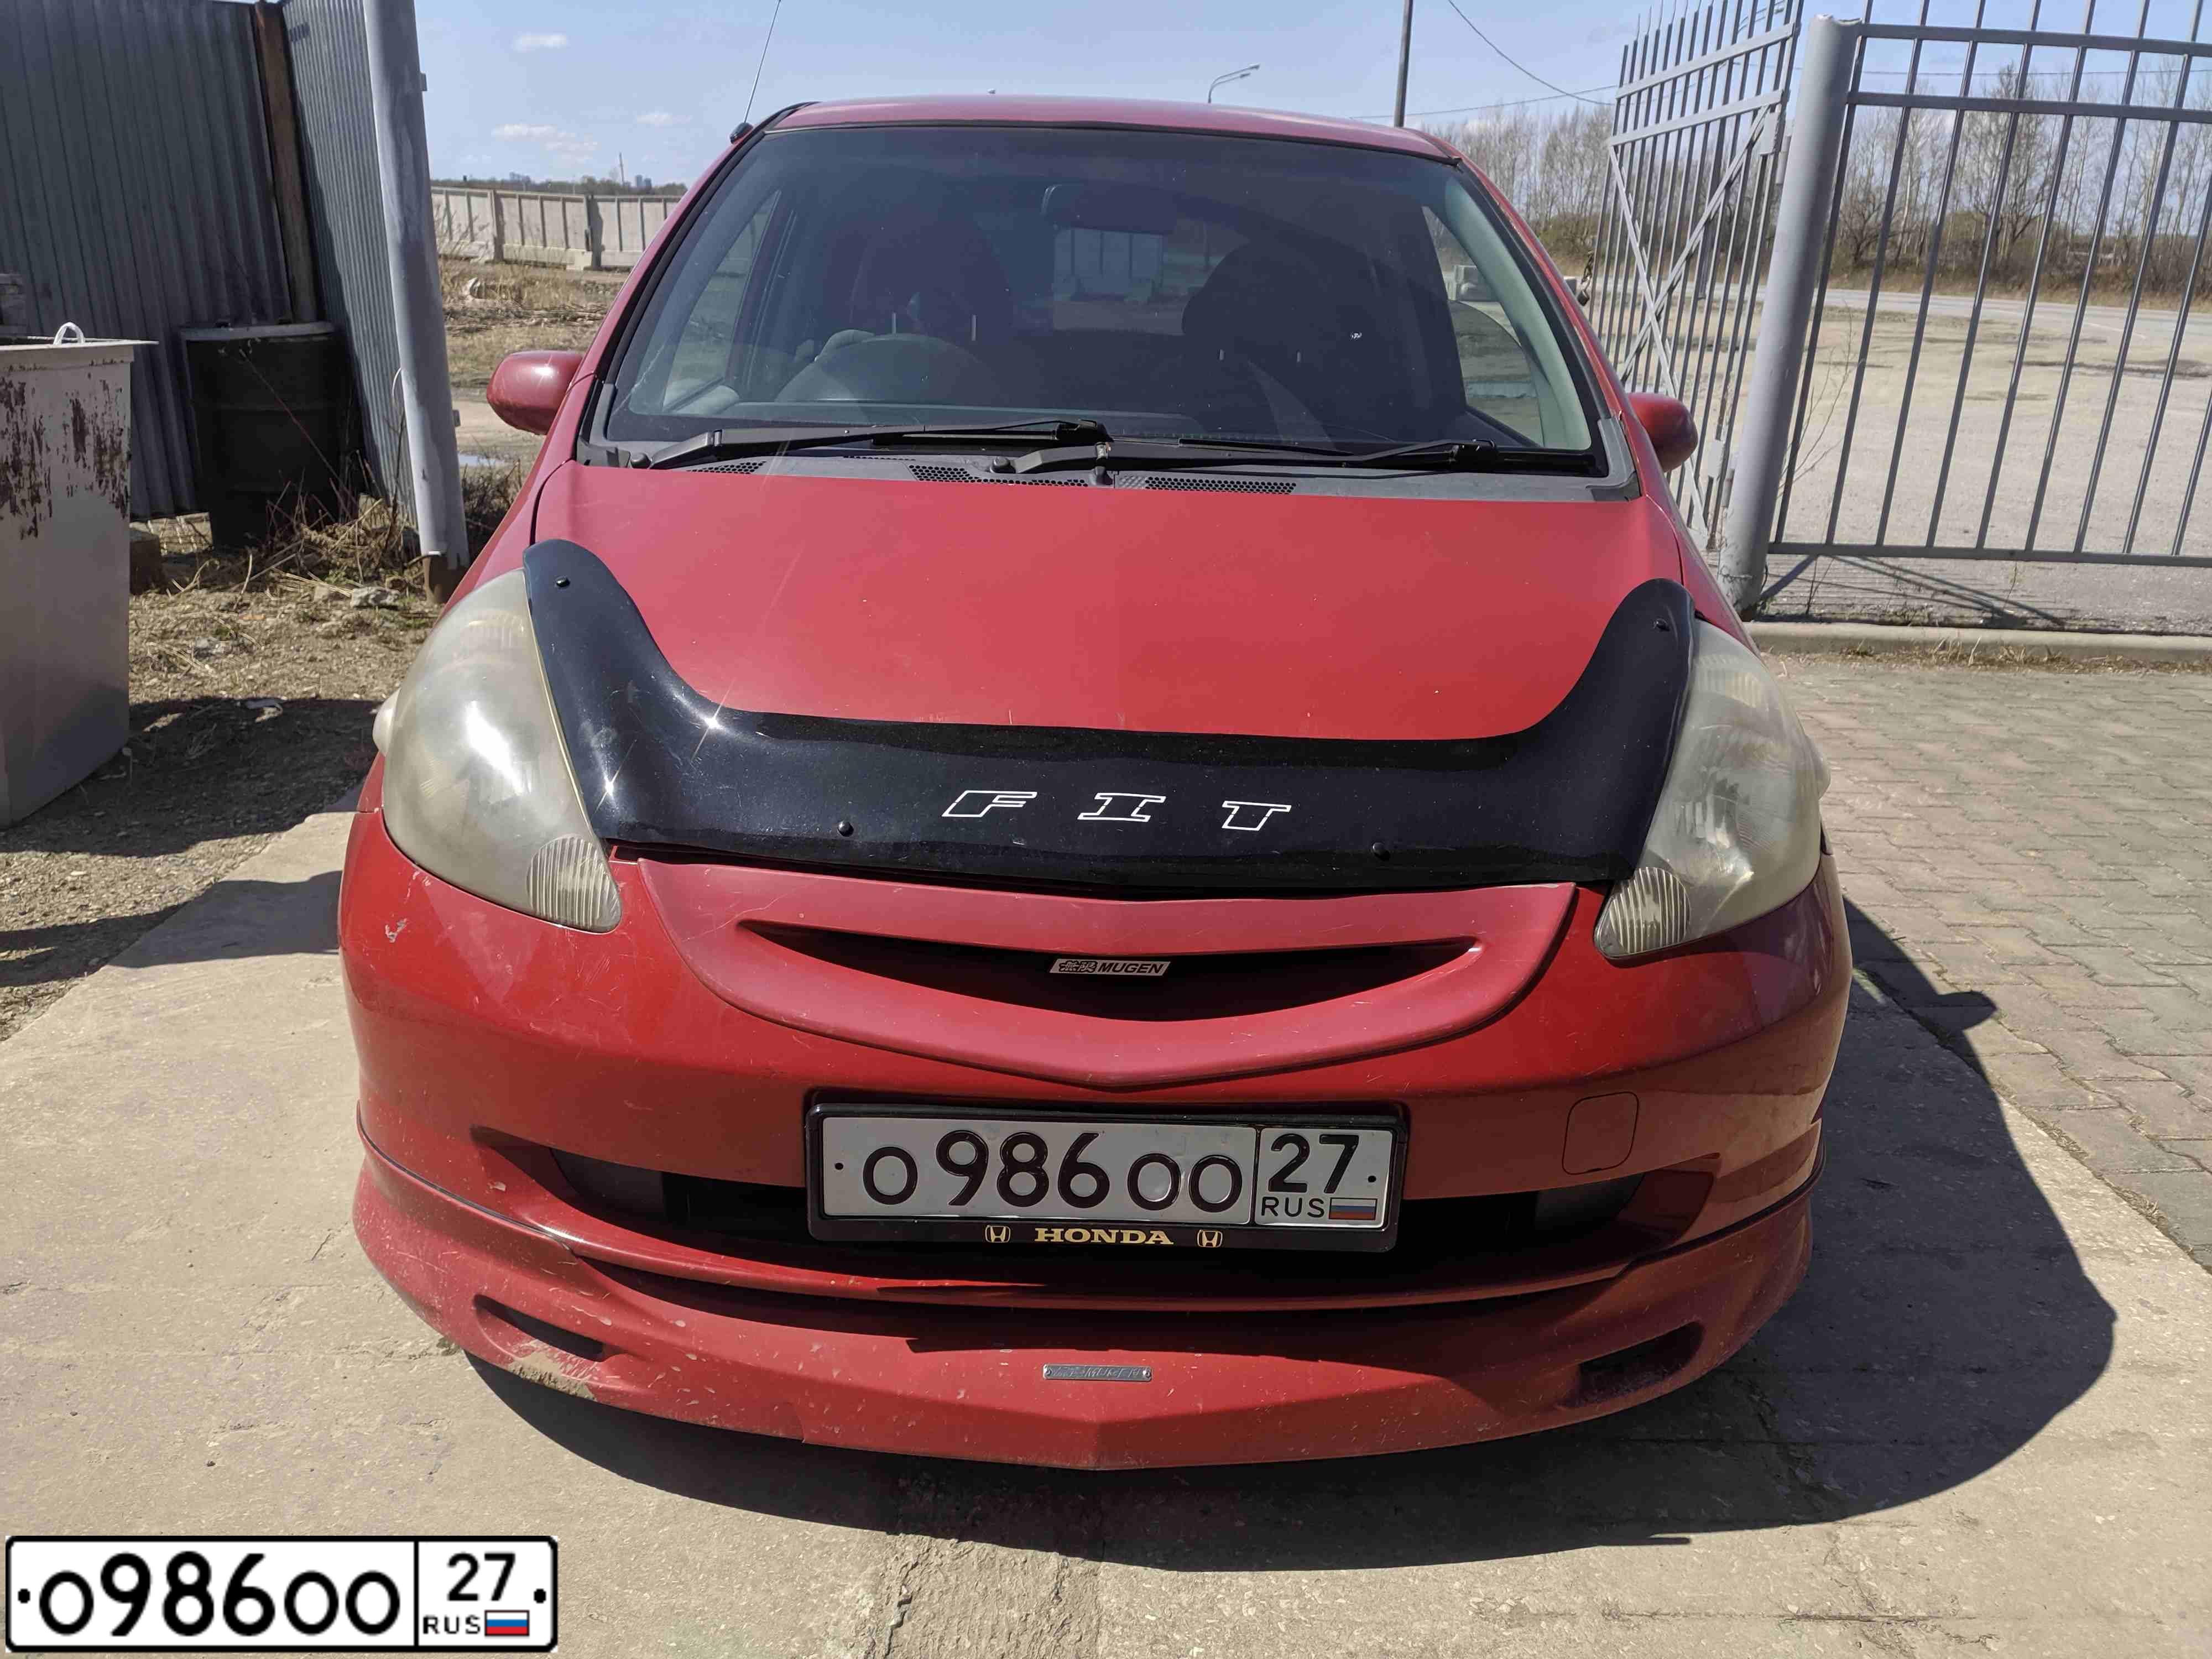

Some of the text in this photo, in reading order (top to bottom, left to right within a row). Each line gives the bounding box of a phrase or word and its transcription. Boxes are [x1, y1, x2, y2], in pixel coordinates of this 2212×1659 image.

[941, 790, 1292, 831] FIT
[1098, 962, 1164, 974] MUGEN
[1268, 1133, 1360, 1194] 27
[1261, 1196, 1325, 1218] RUS
[1034, 1228, 1174, 1245] HONDA
